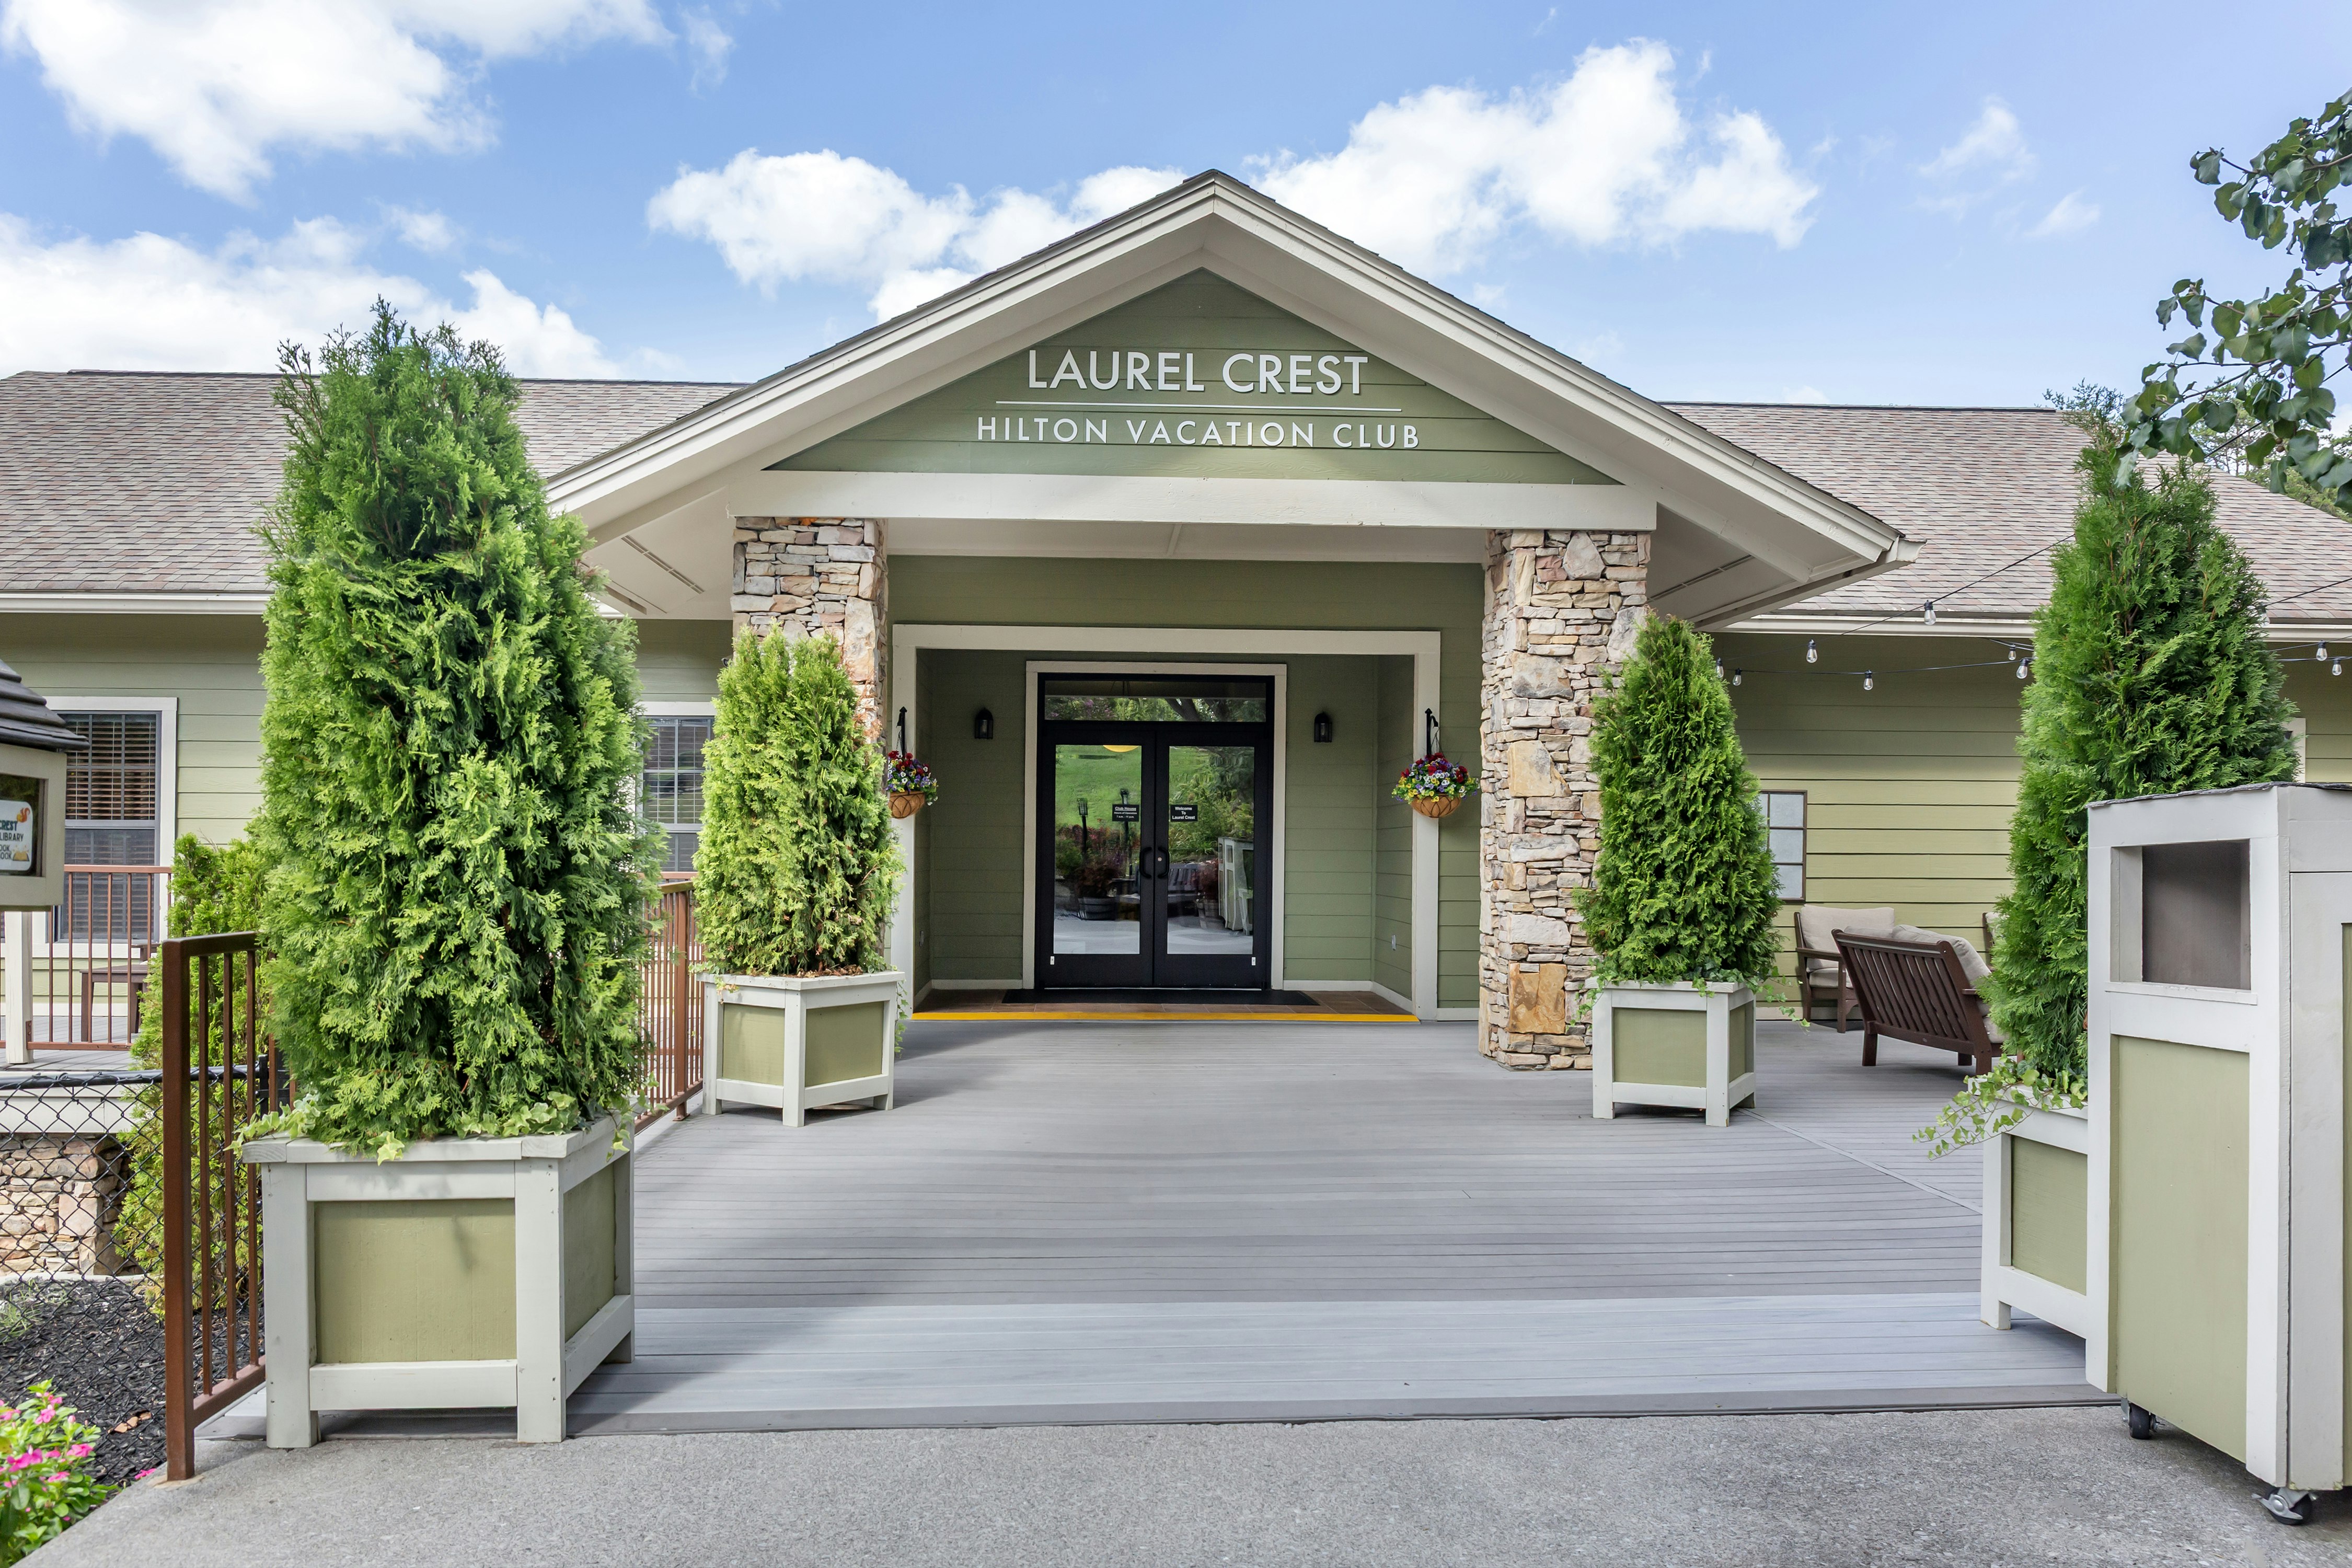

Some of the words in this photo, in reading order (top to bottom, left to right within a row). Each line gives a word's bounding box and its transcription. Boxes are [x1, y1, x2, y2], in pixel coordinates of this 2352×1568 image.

[1029, 349, 1204, 391] LAUREL
[1222, 353, 1368, 394] CREST
[978, 417, 1107, 443] HILTON
[1126, 420, 1313, 447] VACATION
[1333, 423, 1419, 448] CLUB
[0, 832, 24, 841] LIBRARY
[0, 851, 12, 860] OOK
